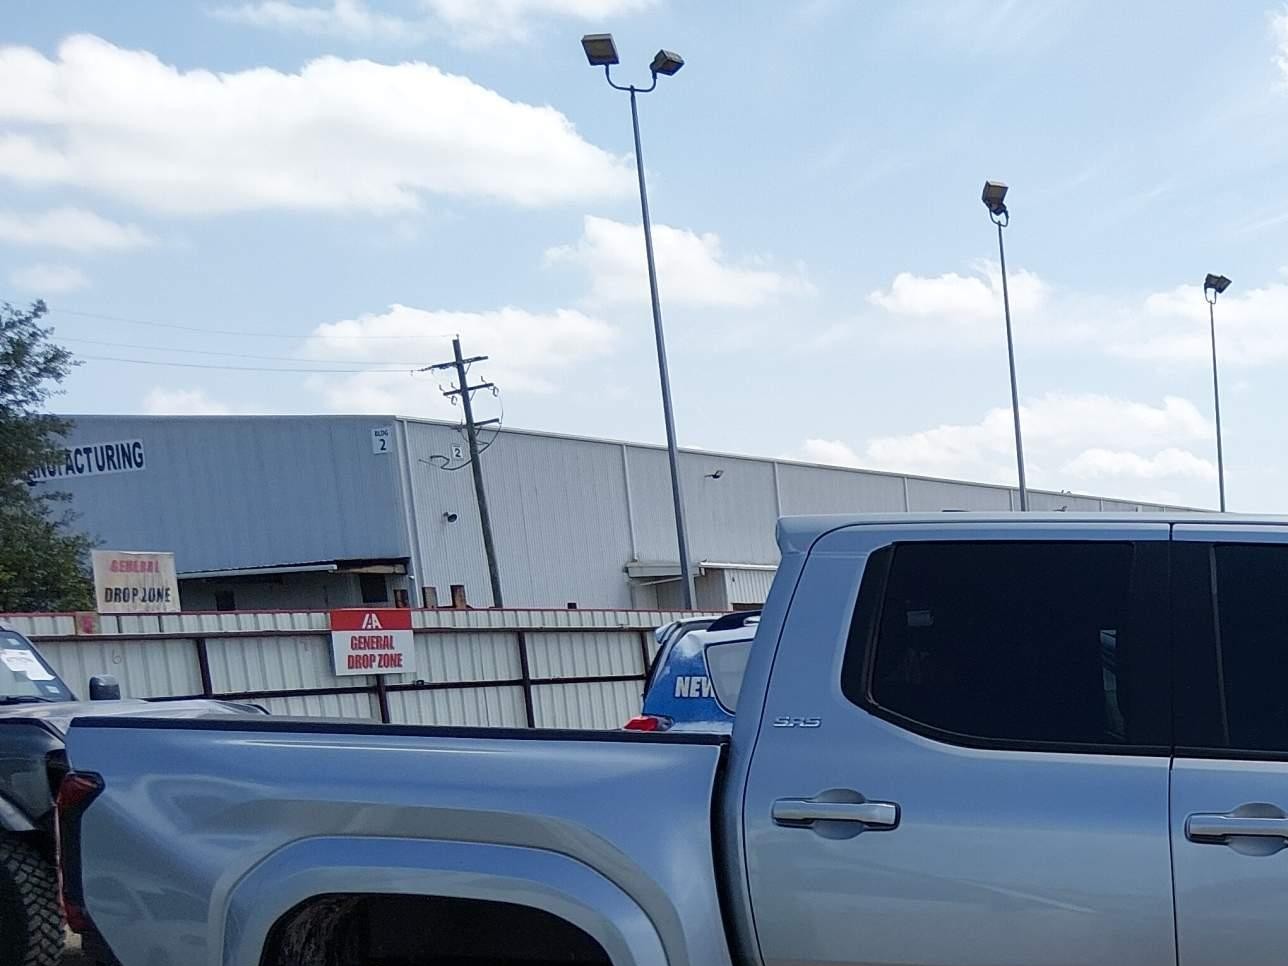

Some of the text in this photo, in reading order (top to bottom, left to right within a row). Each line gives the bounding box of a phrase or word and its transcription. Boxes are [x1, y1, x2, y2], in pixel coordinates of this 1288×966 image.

[379, 438, 387, 451] 2
[454, 447, 461, 458] 2
[110, 559, 160, 573] GENERAL
[104, 586, 171, 603] DROP ZONE
[350, 634, 395, 651] GENERAL
[347, 653, 403, 669] DROP ZONE
